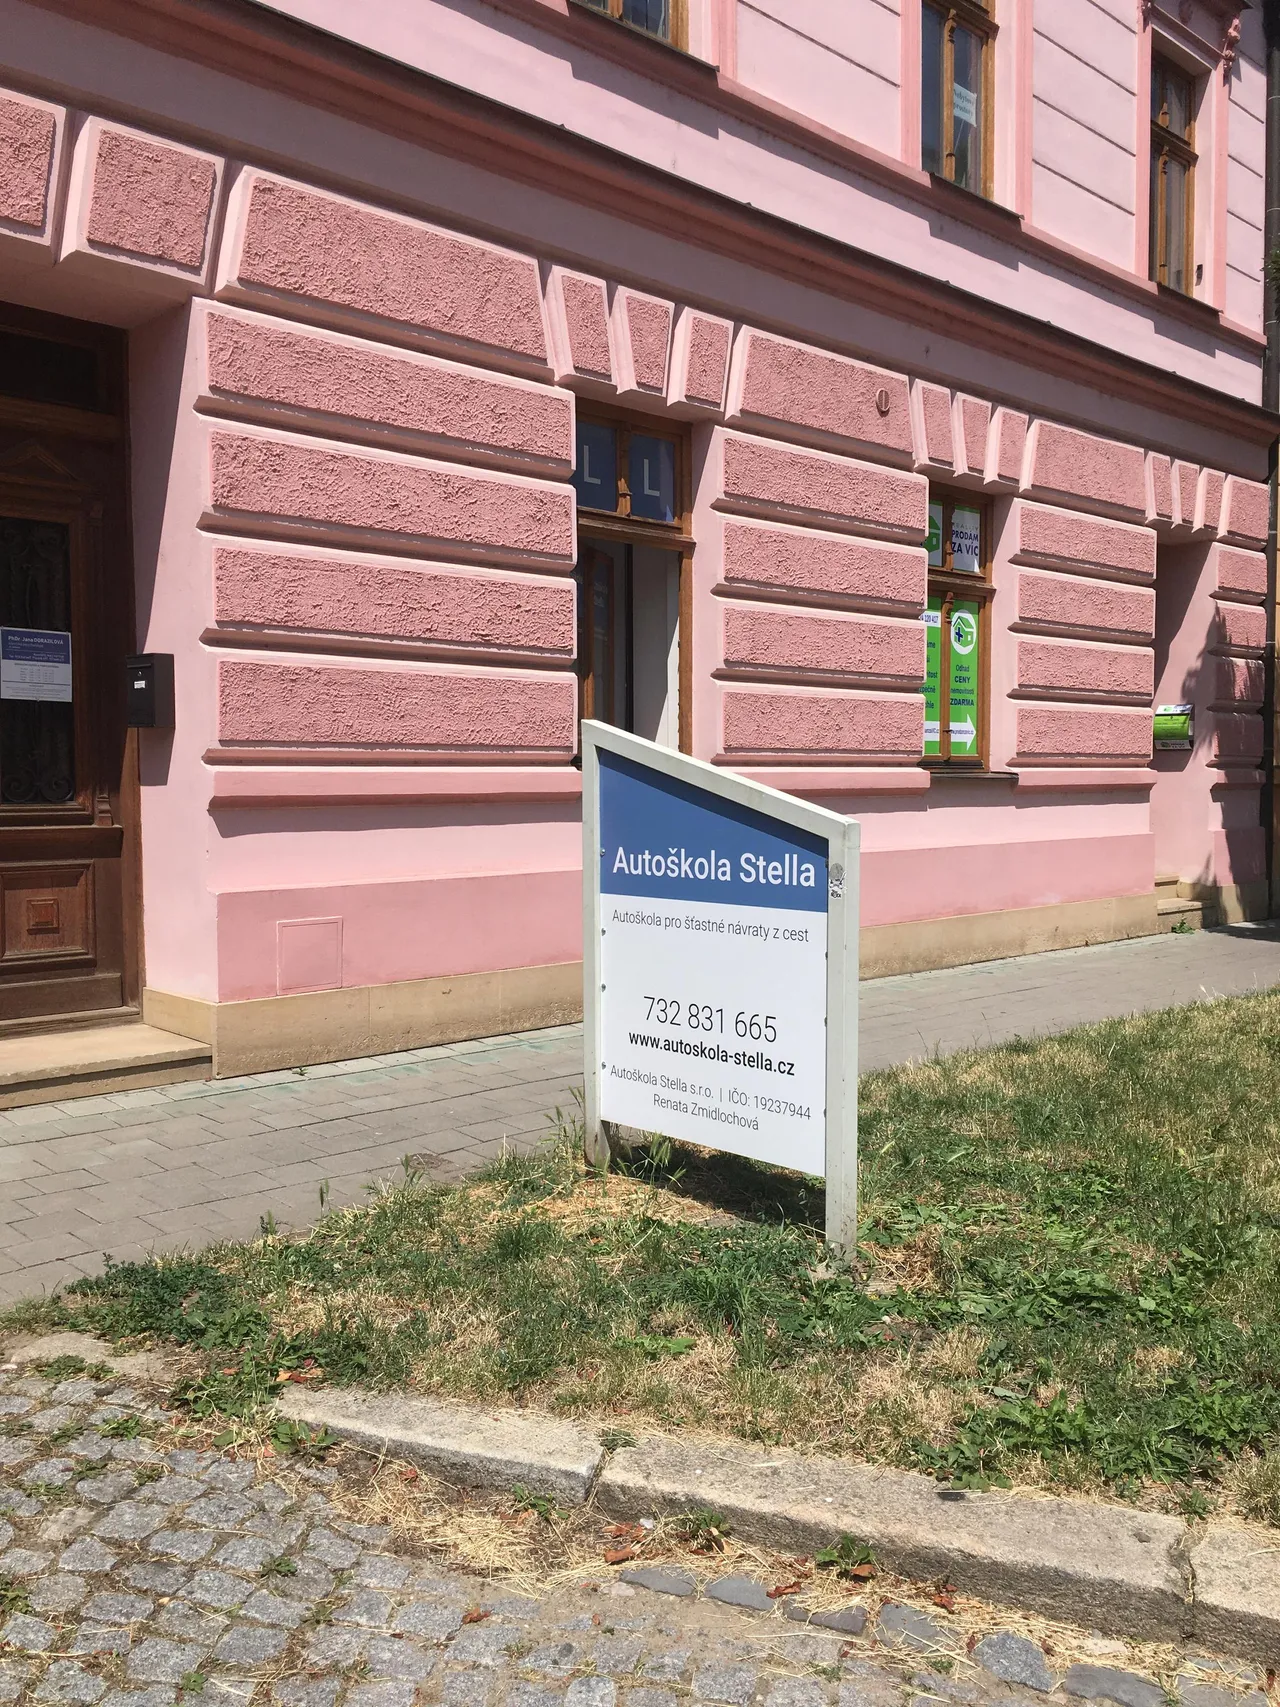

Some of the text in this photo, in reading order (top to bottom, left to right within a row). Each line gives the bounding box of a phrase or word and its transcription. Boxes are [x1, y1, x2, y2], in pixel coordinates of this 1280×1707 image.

[583, 445, 660, 497] L L
[952, 530, 979, 542] PRODÁM
[952, 541, 979, 557] ZA VÍC
[954, 676, 970, 684] CENY
[950, 698, 974, 706] ZDARMA
[612, 846, 816, 887] Autoškola Stella
[612, 909, 809, 943] Autoškola pro šťastné návraty z cest
[643, 996, 778, 1043] 732 831 665
[628, 1031, 796, 1077] www.autoskola-stella.cz
[610, 1064, 812, 1121] Autoškola Stella s.r.o. IČO: 19237944
[653, 1094, 760, 1131] Renata Zmidlochová
